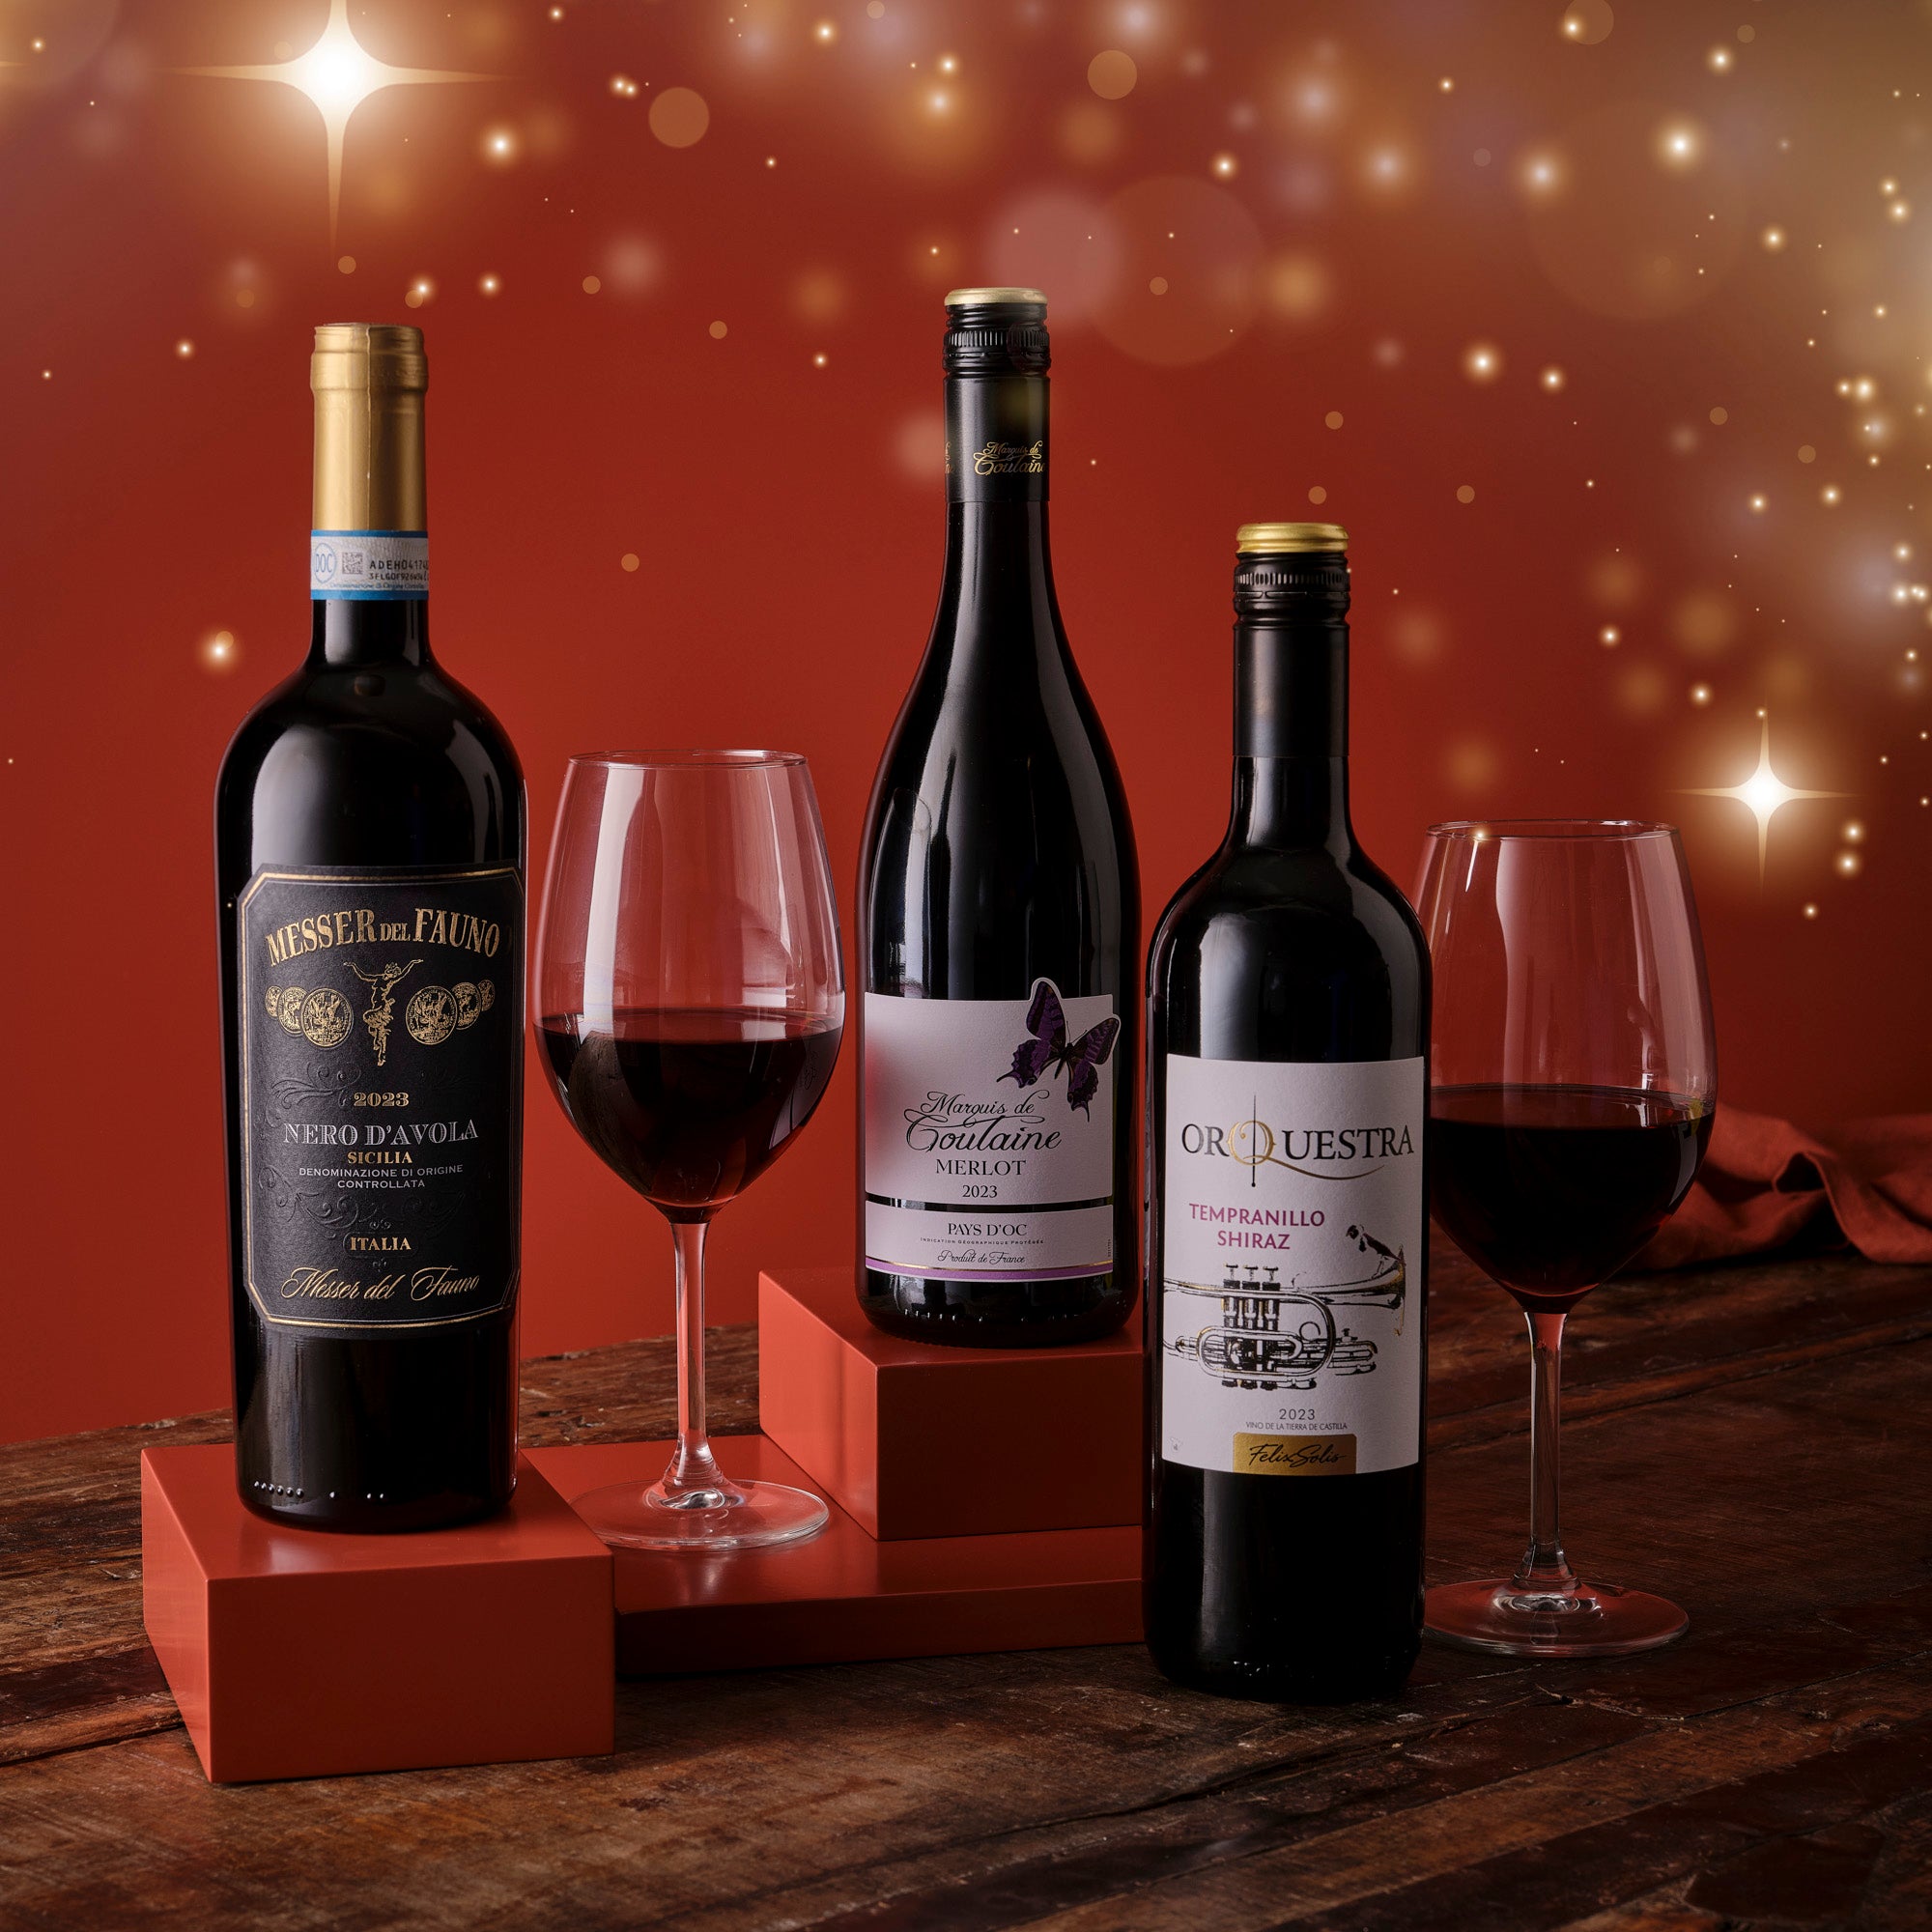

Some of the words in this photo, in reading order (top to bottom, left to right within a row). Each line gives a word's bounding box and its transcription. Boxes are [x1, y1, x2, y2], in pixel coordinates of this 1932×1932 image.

[315, 553, 333, 573] DOC
[265, 909, 376, 967] MESSER
[380, 923, 411, 942] DEL
[414, 908, 500, 958] FAUNO
[354, 1092, 410, 1107] 2023
[920, 1091, 1008, 1124] Marquis
[1014, 1090, 1050, 1114] de
[283, 1123, 358, 1146] NERO
[364, 1119, 479, 1146] D'AVOLA
[347, 1151, 412, 1165] SICILIA
[1181, 1121, 1415, 1180] ORQUESTRA
[298, 1167, 398, 1178] DENOMINAZIONE
[401, 1168, 413, 1178] DI
[416, 1164, 464, 1177] ORIGINE
[935, 1159, 1027, 1177] MERLOT
[337, 1179, 425, 1189] CONTROLLATA
[962, 1184, 998, 1198] 2023
[1189, 1203, 1325, 1228] TEMPRANILLO
[948, 1223, 982, 1236] PAYS
[986, 1223, 1028, 1236] D'OC
[350, 1236, 412, 1251] ITALIA
[1217, 1230, 1291, 1251] SHIRAZ
[937, 1249, 976, 1264] Produit
[978, 1252, 987, 1264] de
[989, 1251, 1026, 1264] France
[281, 1266, 360, 1300] Messer
[364, 1274, 406, 1300] del
[411, 1264, 480, 1301] Fauno
[1279, 1408, 1316, 1421] 2023
[1245, 1421, 1264, 1430] VINO
[1276, 1422, 1285, 1431] LA
[1320, 1422, 1349, 1431] CASTILLA
